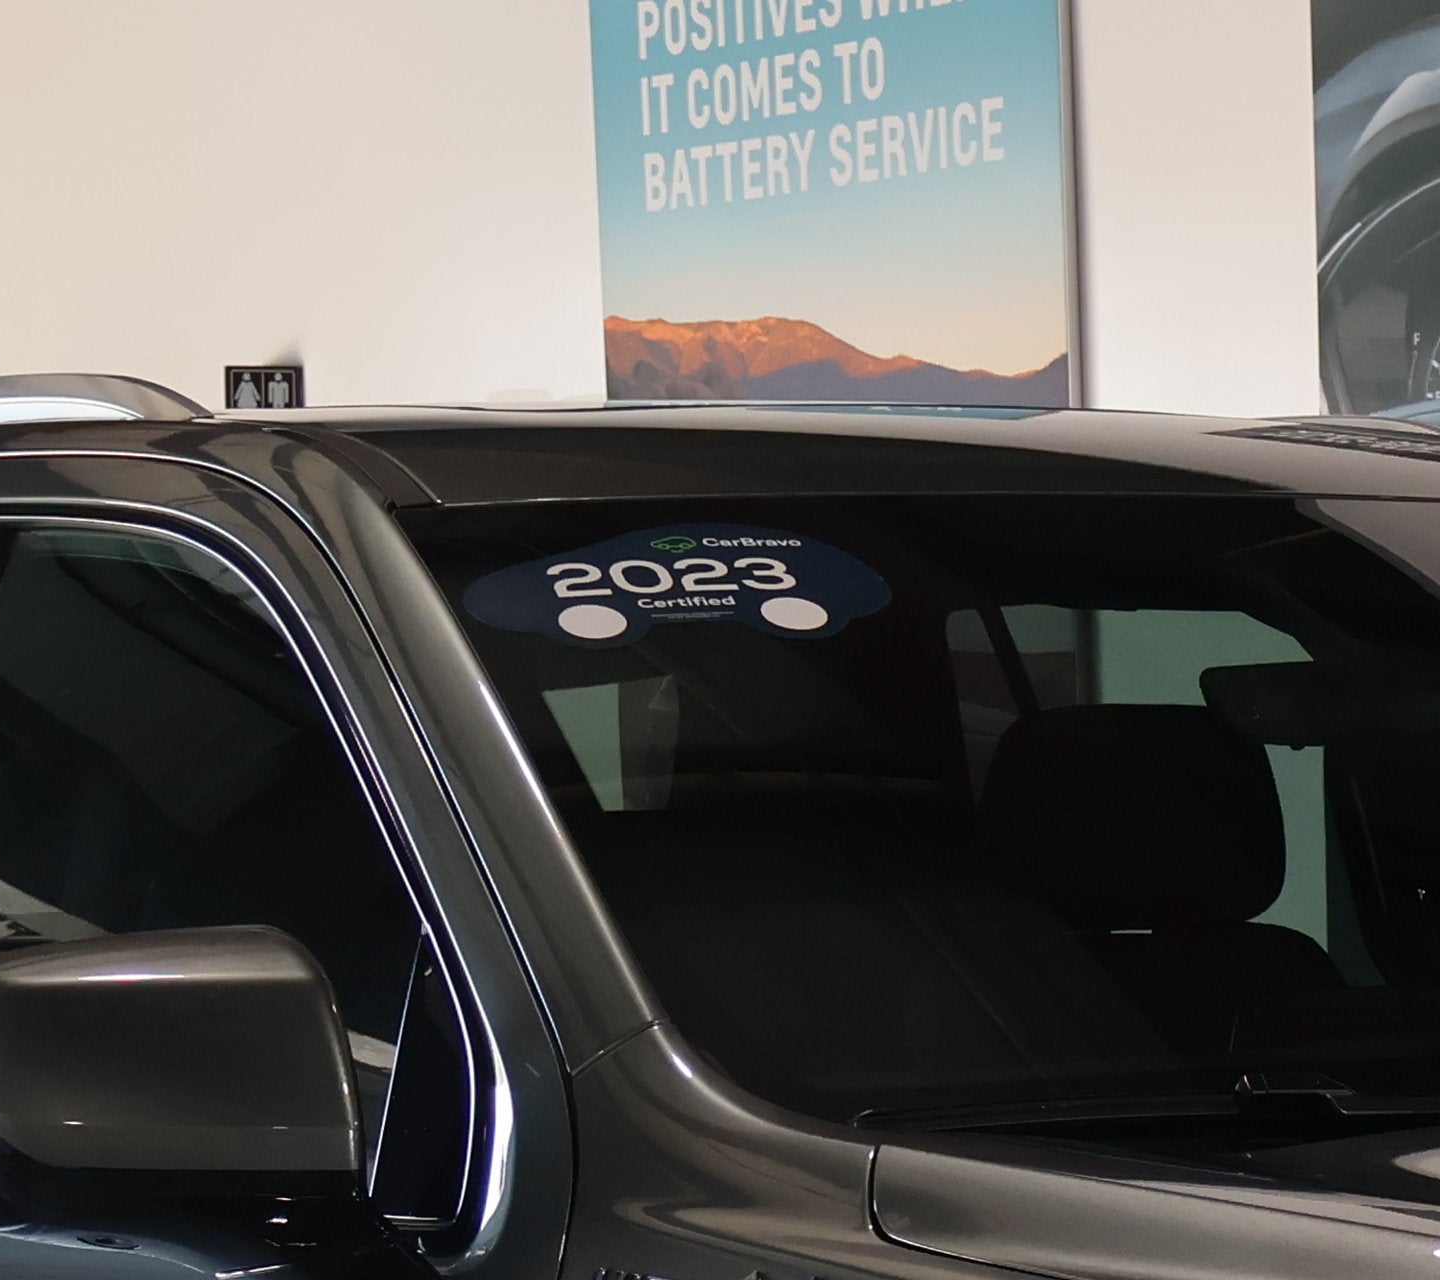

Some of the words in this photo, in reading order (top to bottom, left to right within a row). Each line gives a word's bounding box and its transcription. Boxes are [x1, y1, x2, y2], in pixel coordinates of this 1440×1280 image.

[641, 71, 674, 136] IT
[687, 48, 822, 130] COMES
[833, 37, 887, 104] TO
[644, 130, 816, 212] BATTERY
[828, 97, 1006, 187] SERVICE
[702, 537, 802, 547] CarBravo
[546, 557, 798, 599] 2023
[637, 595, 736, 609] Certified
